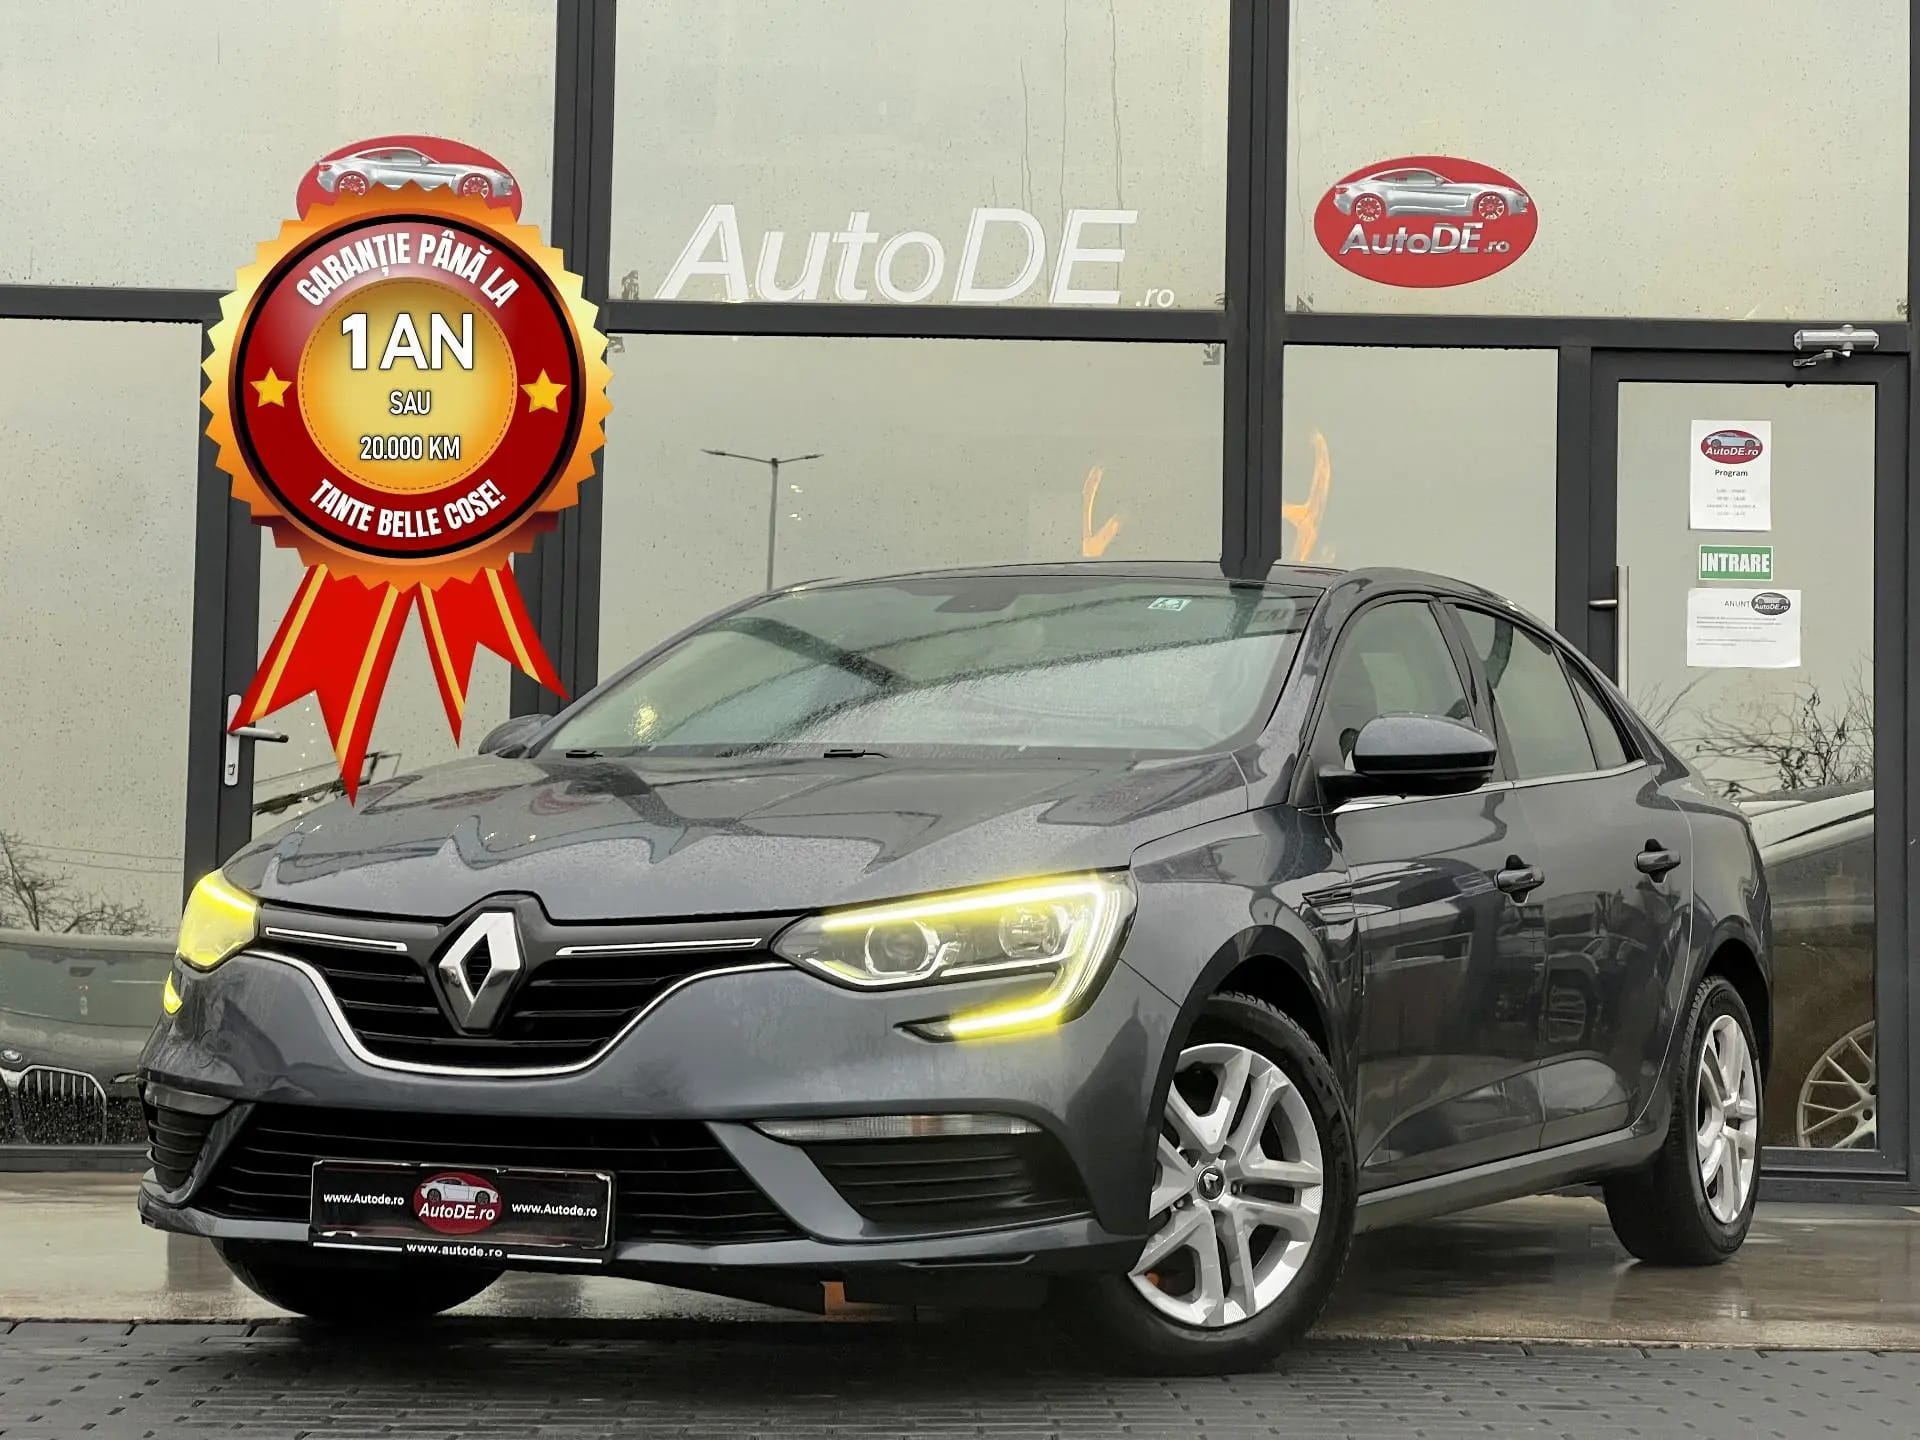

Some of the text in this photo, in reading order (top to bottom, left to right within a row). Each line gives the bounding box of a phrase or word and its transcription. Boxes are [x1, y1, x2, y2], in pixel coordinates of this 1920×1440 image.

[1705, 446, 1759, 457] AutoDE.ro
[1715, 469, 1748, 478] Program
[1701, 552, 1770, 573] INTRARE
[323, 1192, 404, 1206] www.Autode.ro
[418, 1201, 496, 1221] AutoDE.ro
[511, 1202, 598, 1218] www.Autode.ro
[406, 1242, 503, 1258] www.autode.ro
